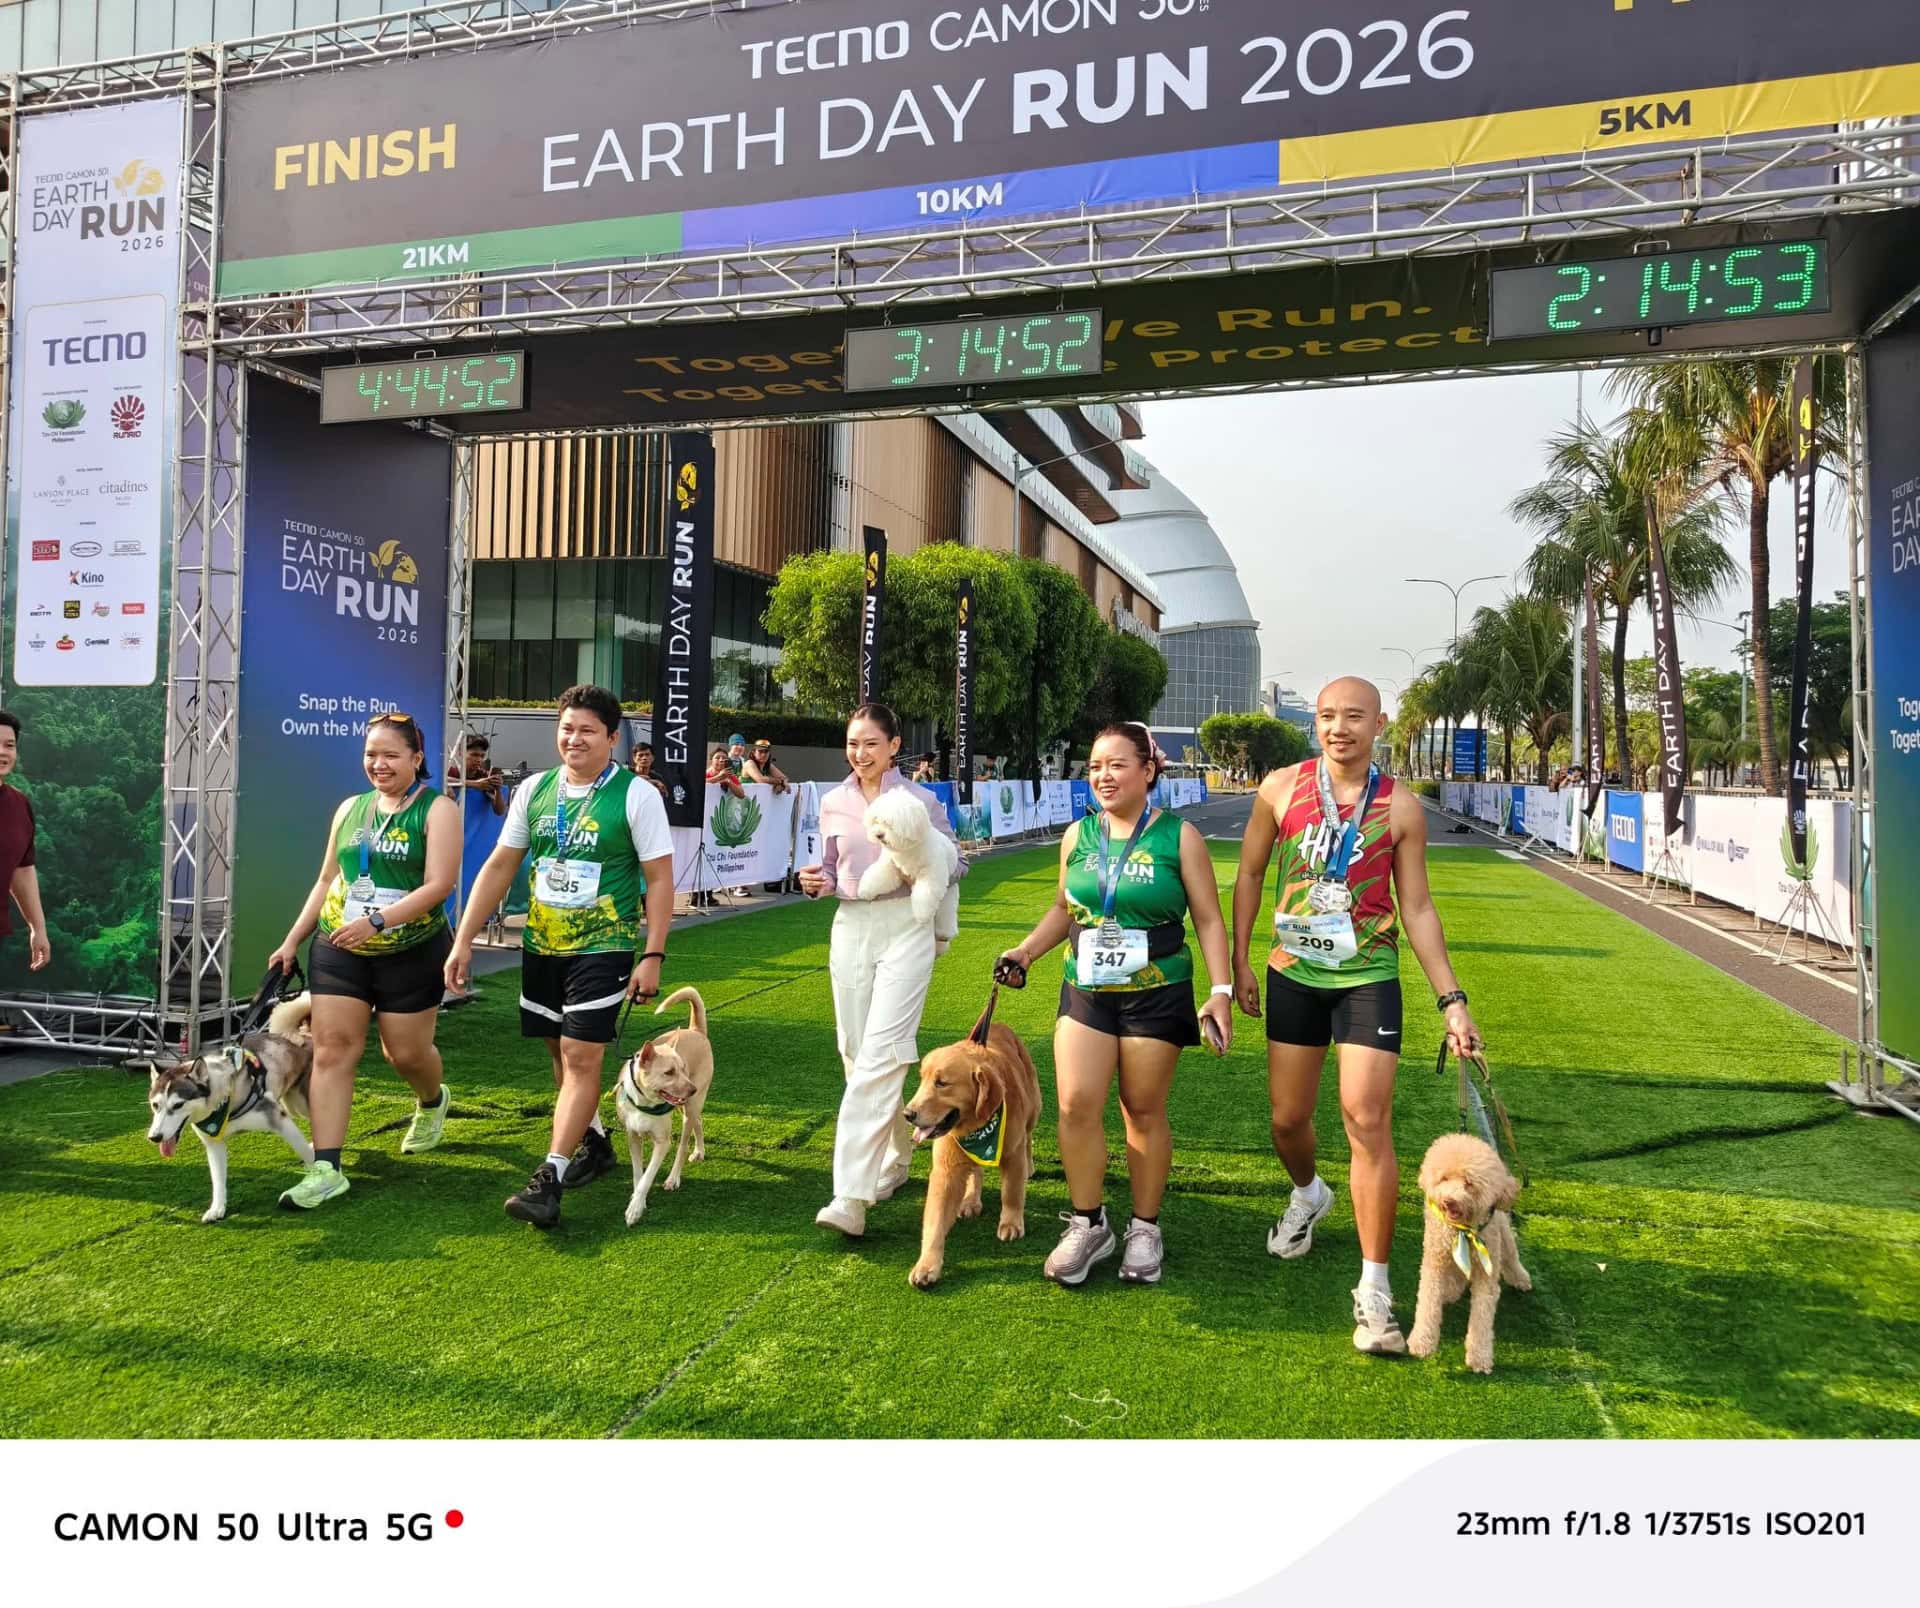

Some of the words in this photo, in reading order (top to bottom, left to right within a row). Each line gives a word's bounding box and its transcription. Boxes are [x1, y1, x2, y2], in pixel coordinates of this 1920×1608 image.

[741, 20, 909, 79] TECNO
[543, 107, 785, 192] EARTH
[819, 78, 986, 159] DAY
[1012, 46, 1208, 134] RUN
[1240, 11, 1474, 104] 2026
[1599, 100, 1691, 136] 5KM
[274, 123, 456, 191] FINISH
[33, 180, 109, 208] EARTH
[916, 181, 1004, 214] 10KM
[33, 208, 75, 232] DAY
[80, 197, 166, 240] RUN
[121, 235, 164, 252] 2026
[402, 242, 470, 270] 21KM
[1216, 299, 1433, 333] Run.
[42, 331, 147, 367] TECNO
[99, 480, 149, 495] citadines
[284, 519, 317, 536] TECNO
[319, 528, 352, 544] CAMON
[283, 535, 365, 575] EARTH
[672, 521, 695, 588] RUN
[81, 572, 104, 584] Kino
[282, 564, 330, 596] DAY
[336, 575, 419, 626] RUN
[378, 626, 418, 644] 2026
[671, 596, 693, 657] DAY
[959, 629, 968, 668] RUN
[1658, 638, 1671, 691] DAY
[299, 693, 338, 715] Snap
[342, 695, 366, 712] the
[369, 697, 401, 713] Run.
[665, 666, 690, 764] EARTH
[281, 718, 319, 736] Own
[323, 719, 348, 736] the
[1094, 952, 1126, 967] 347
[1298, 936, 1335, 951] 209
